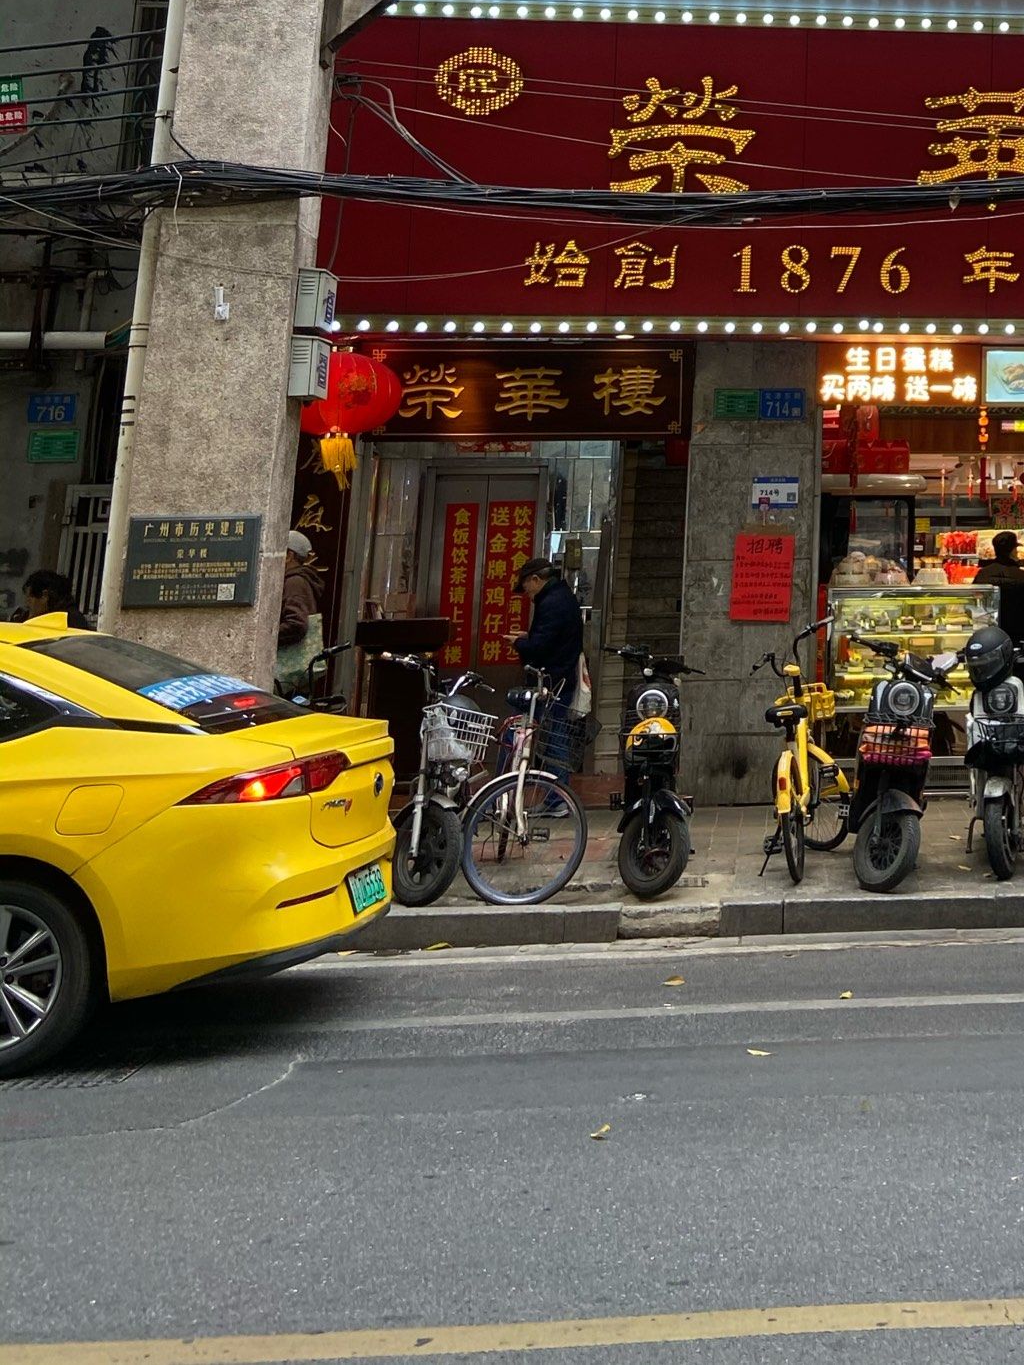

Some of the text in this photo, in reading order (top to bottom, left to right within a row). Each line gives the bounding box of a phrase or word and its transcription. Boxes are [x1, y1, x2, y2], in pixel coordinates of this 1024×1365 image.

[845, 347, 954, 373] 生日蛋糕
[398, 362, 667, 422] 榮華樓
[820, 374, 977, 402] 买两磅 送一磅
[37, 405, 66, 421] 716
[766, 401, 789, 417] 714
[143, 521, 246, 537] 广州市历史建筑
[746, 537, 783, 555] 招聘
[482, 507, 510, 662] 送金牌鸡仔饼
